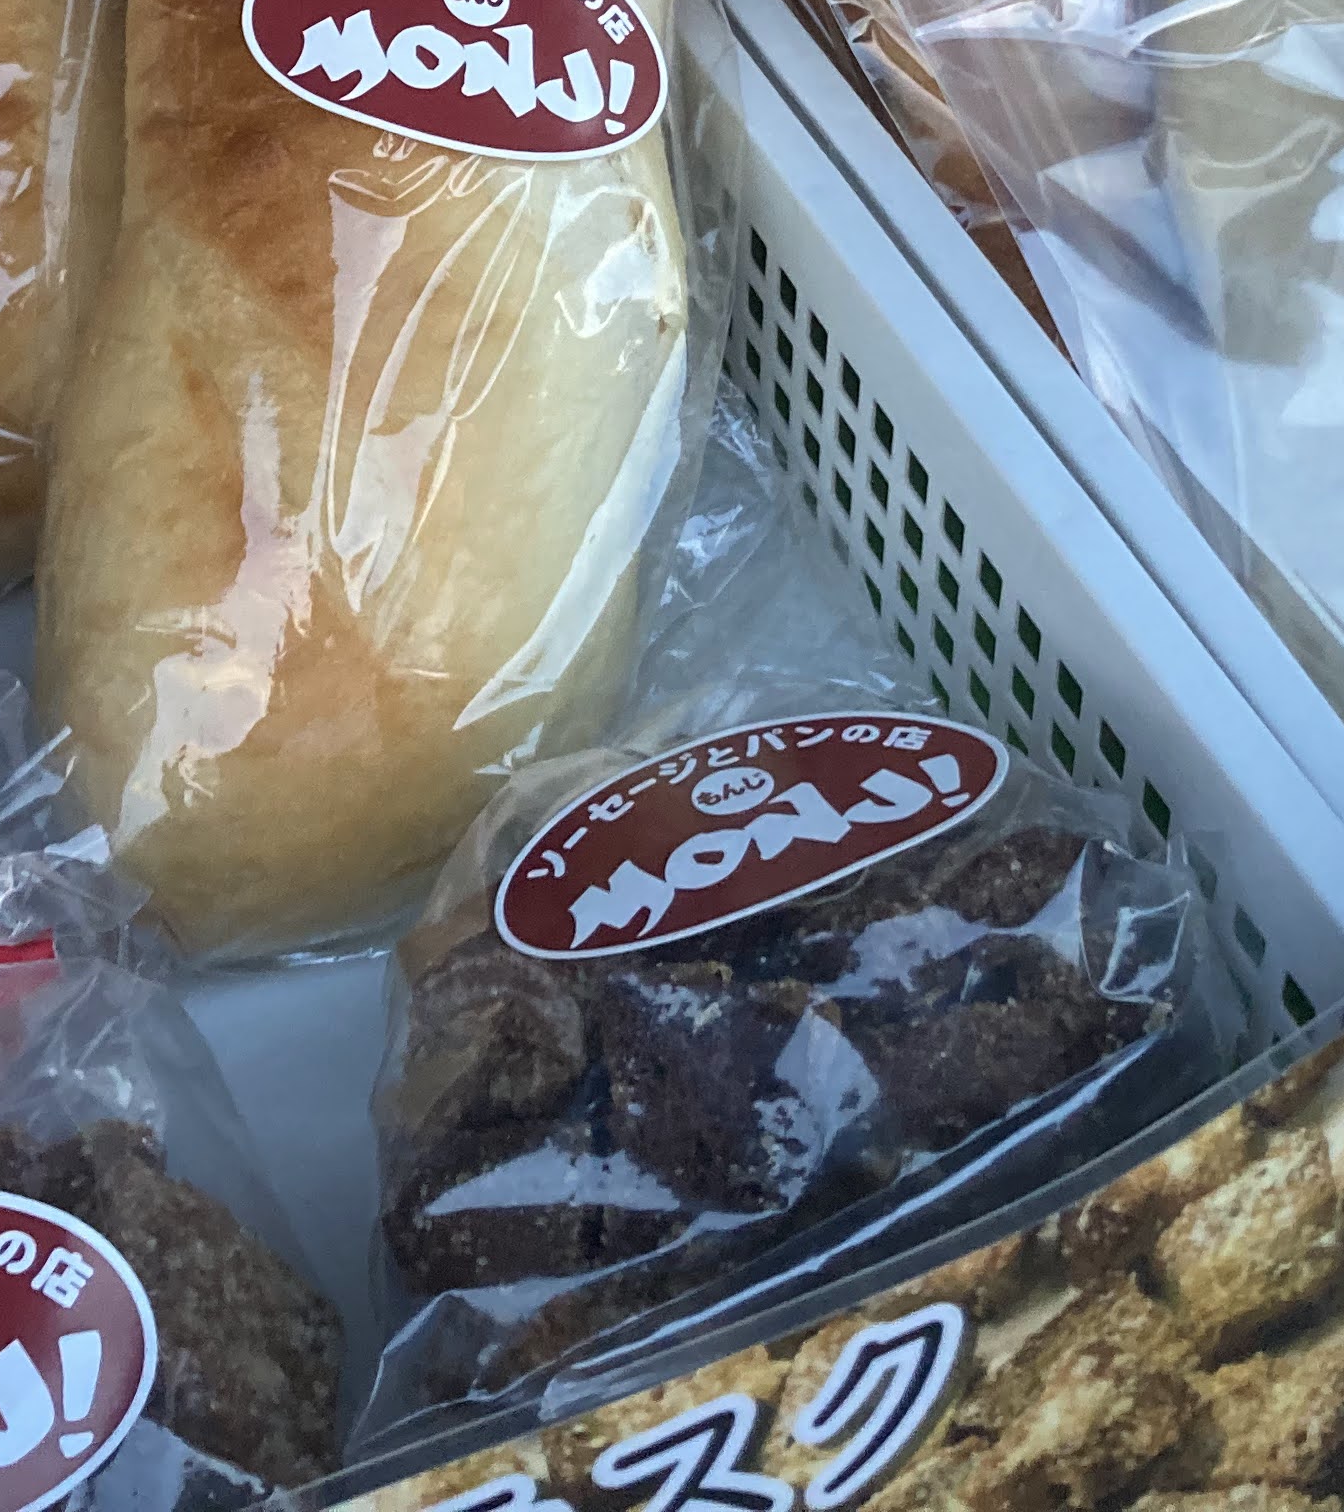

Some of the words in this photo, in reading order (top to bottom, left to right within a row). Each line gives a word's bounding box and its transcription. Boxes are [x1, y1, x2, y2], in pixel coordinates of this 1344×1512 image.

[526, 723, 933, 880] ソーセージとパンの店
[696, 768, 768, 807] もんじ
